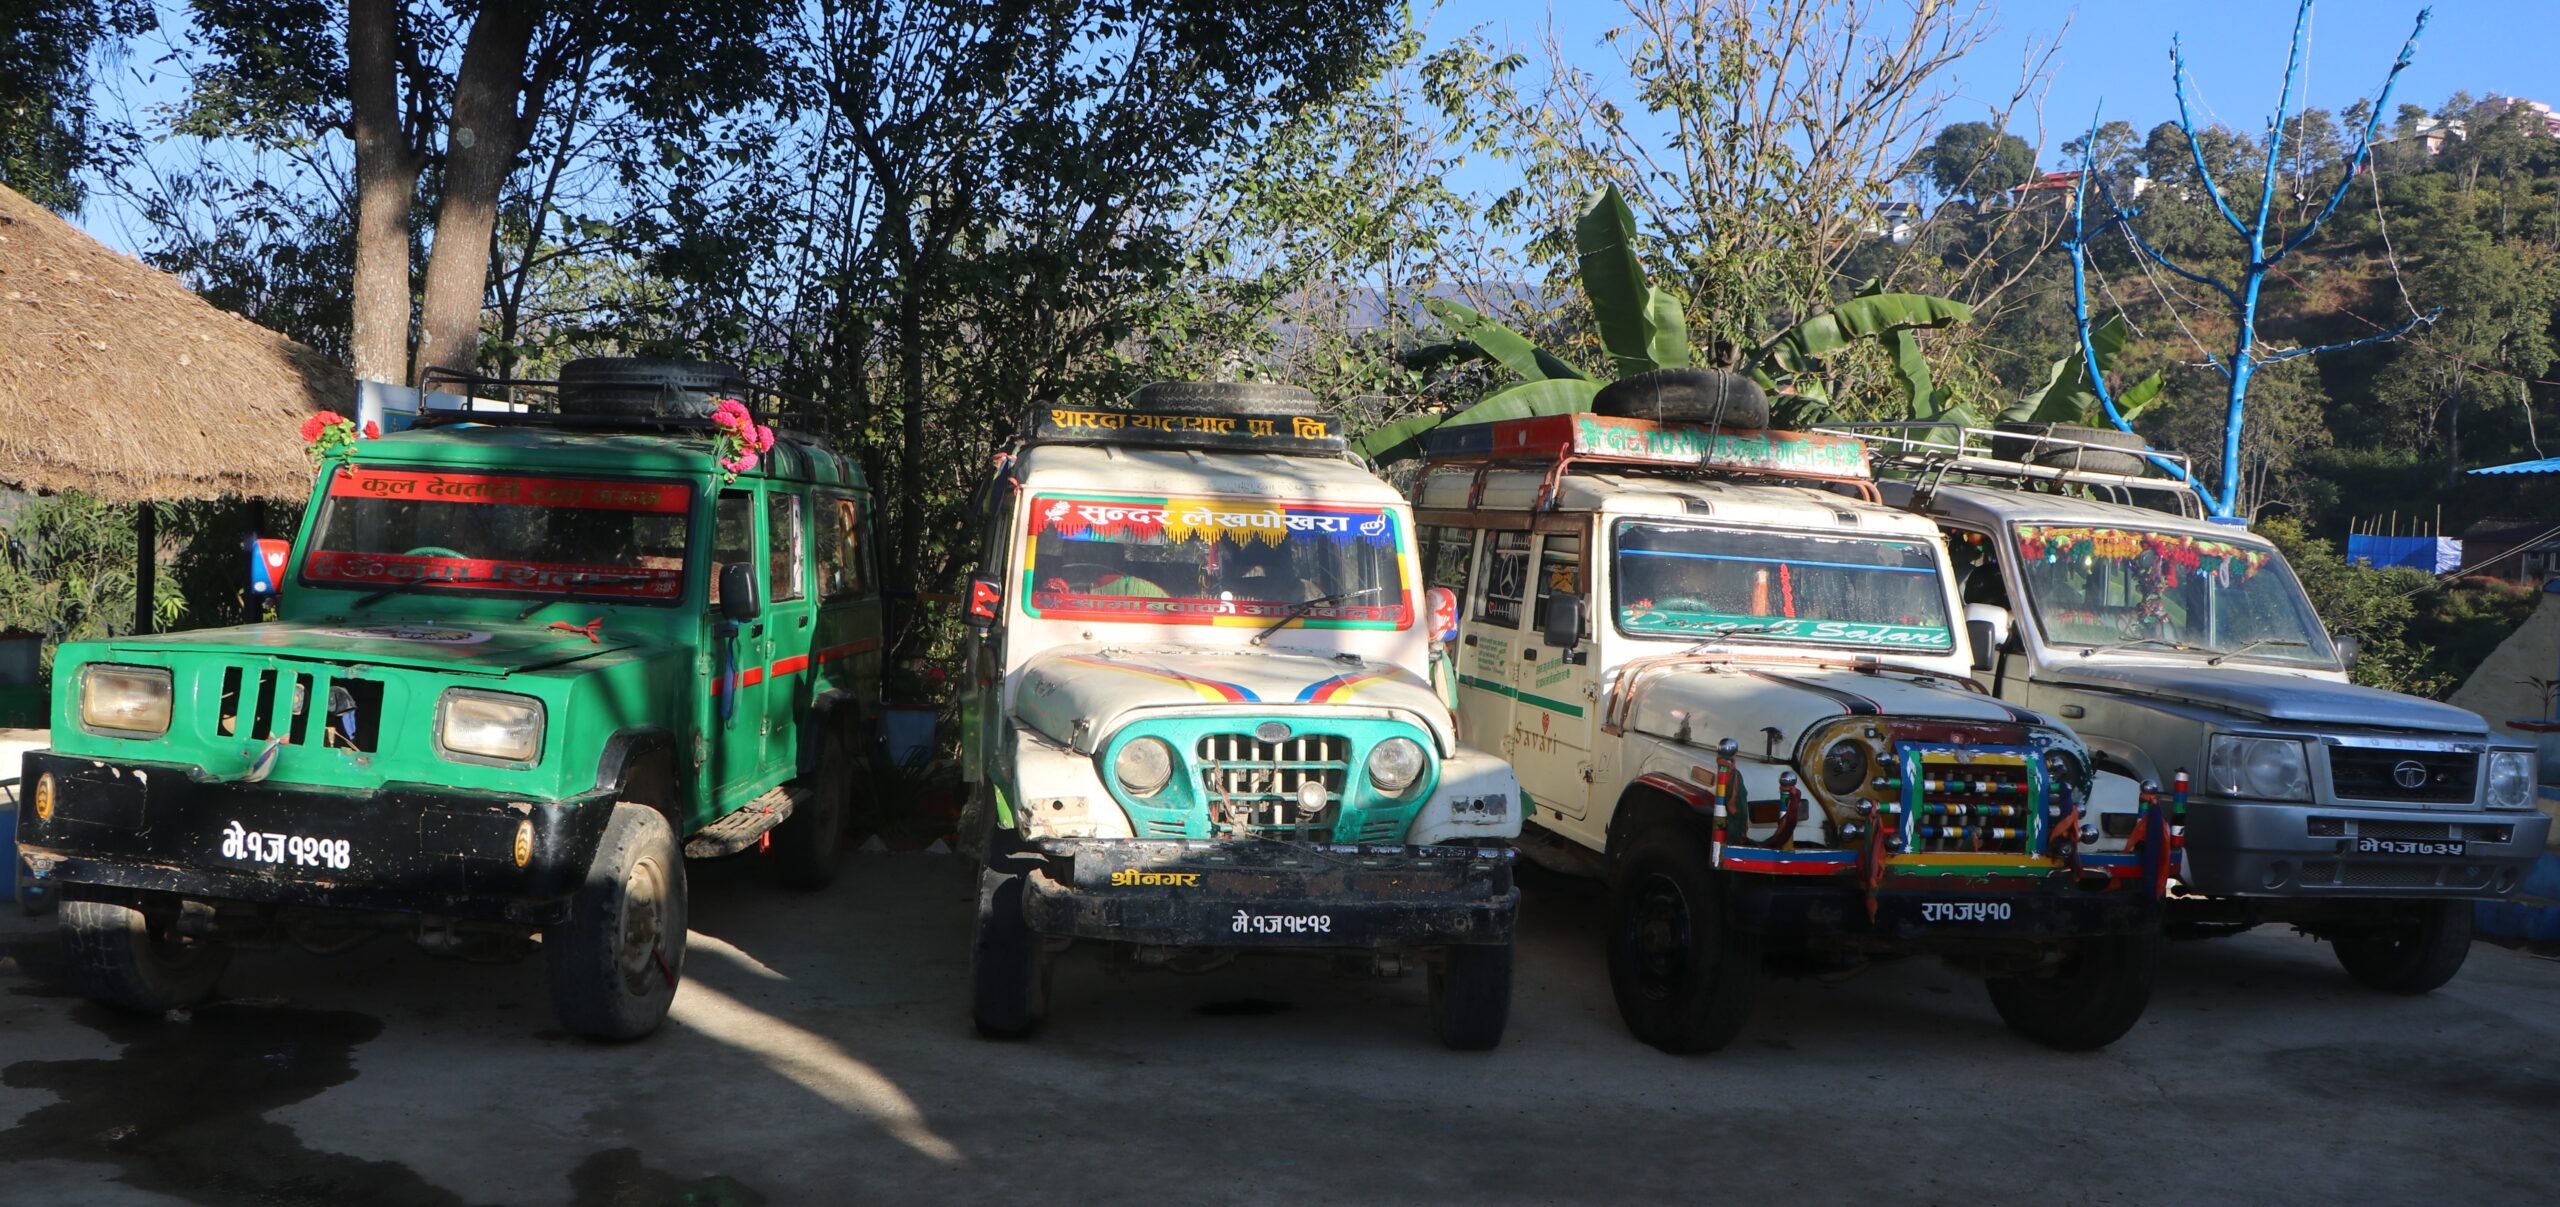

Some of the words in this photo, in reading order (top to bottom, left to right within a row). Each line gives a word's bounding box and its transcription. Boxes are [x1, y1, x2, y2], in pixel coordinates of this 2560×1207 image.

[1051, 409, 1127, 430] शारदा
[1292, 416, 1334, 441] लि.
[1077, 502, 1177, 525] सुन्दर
[1181, 507, 1350, 532] लेखपोखरा
[1810, 622, 1949, 645] Safari
[1111, 868, 1200, 888] श्रीनगर
